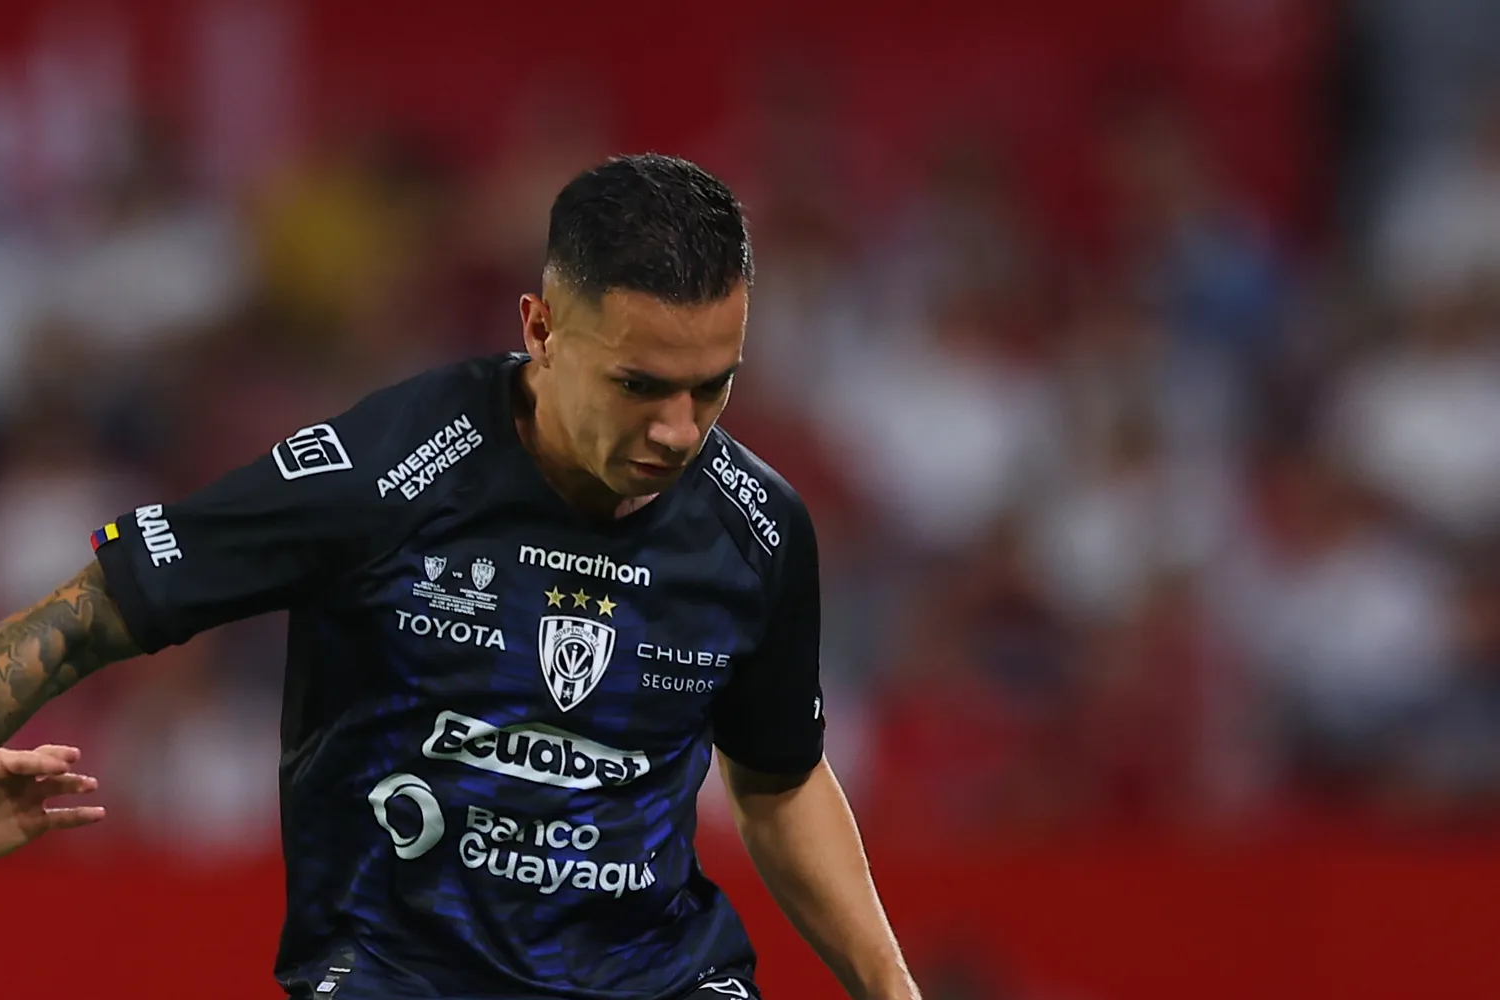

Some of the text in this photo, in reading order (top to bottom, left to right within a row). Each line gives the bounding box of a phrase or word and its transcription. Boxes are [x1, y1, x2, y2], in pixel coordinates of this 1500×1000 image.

[376, 413, 472, 498] AMERICAN
[400, 429, 483, 501] EXPRESS
[518, 544, 651, 587] marathon
[396, 610, 506, 651] TOYOTA
[641, 673, 714, 694] SEGUROS
[431, 718, 641, 786] Ecuabet
[467, 805, 601, 851] Banco
